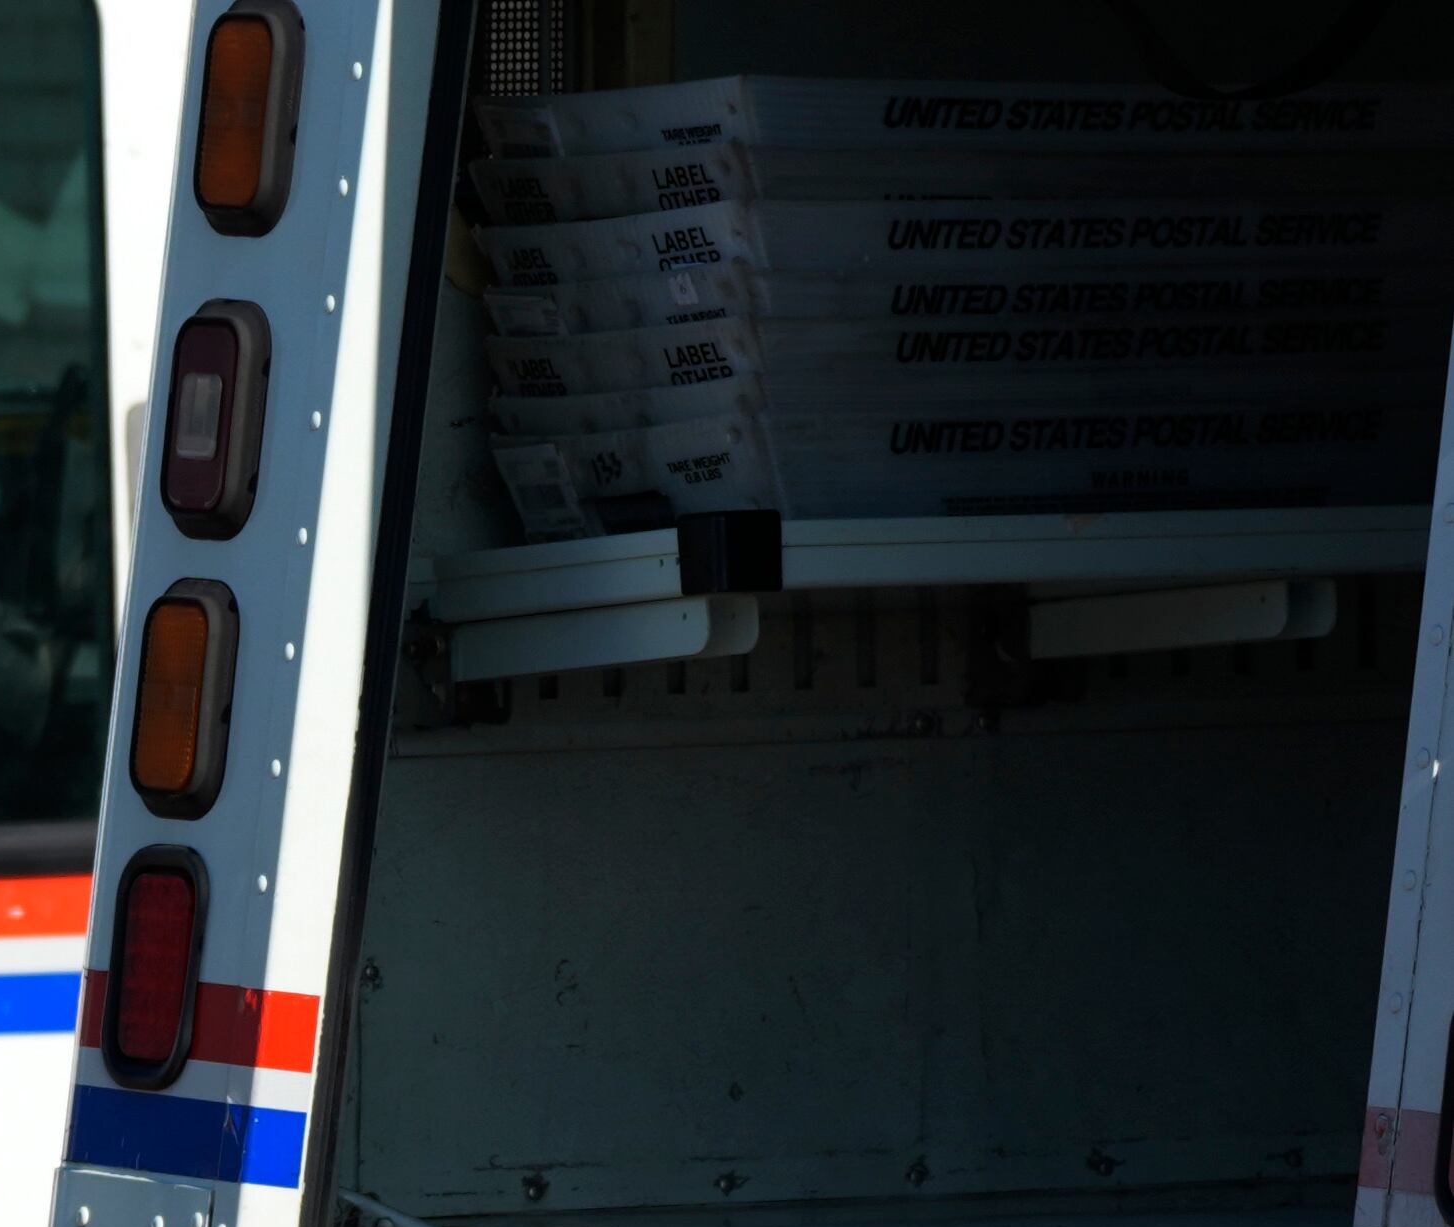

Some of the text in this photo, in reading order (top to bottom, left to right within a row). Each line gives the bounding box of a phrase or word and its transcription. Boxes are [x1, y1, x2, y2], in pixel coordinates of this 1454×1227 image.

[884, 97, 1381, 132] UNITED STATES POSTAL SERVICE
[499, 177, 548, 198] LABEL
[652, 164, 713, 190] LABEL
[658, 188, 720, 210] OTHER
[652, 227, 714, 254] LABEL
[888, 212, 1382, 249] UNITED STATES POSTAL SERVICE
[511, 246, 552, 271] ABEL
[892, 278, 1384, 315] UNITED STATES POSTAL SERVICE
[896, 320, 1388, 362] UNITED STATES POSTAL SERVICE
[664, 343, 726, 368] LABEL
[890, 409, 1383, 454] UNITED STATES POSTAL SERVICE
[667, 453, 731, 474] TARE WEIGHT
